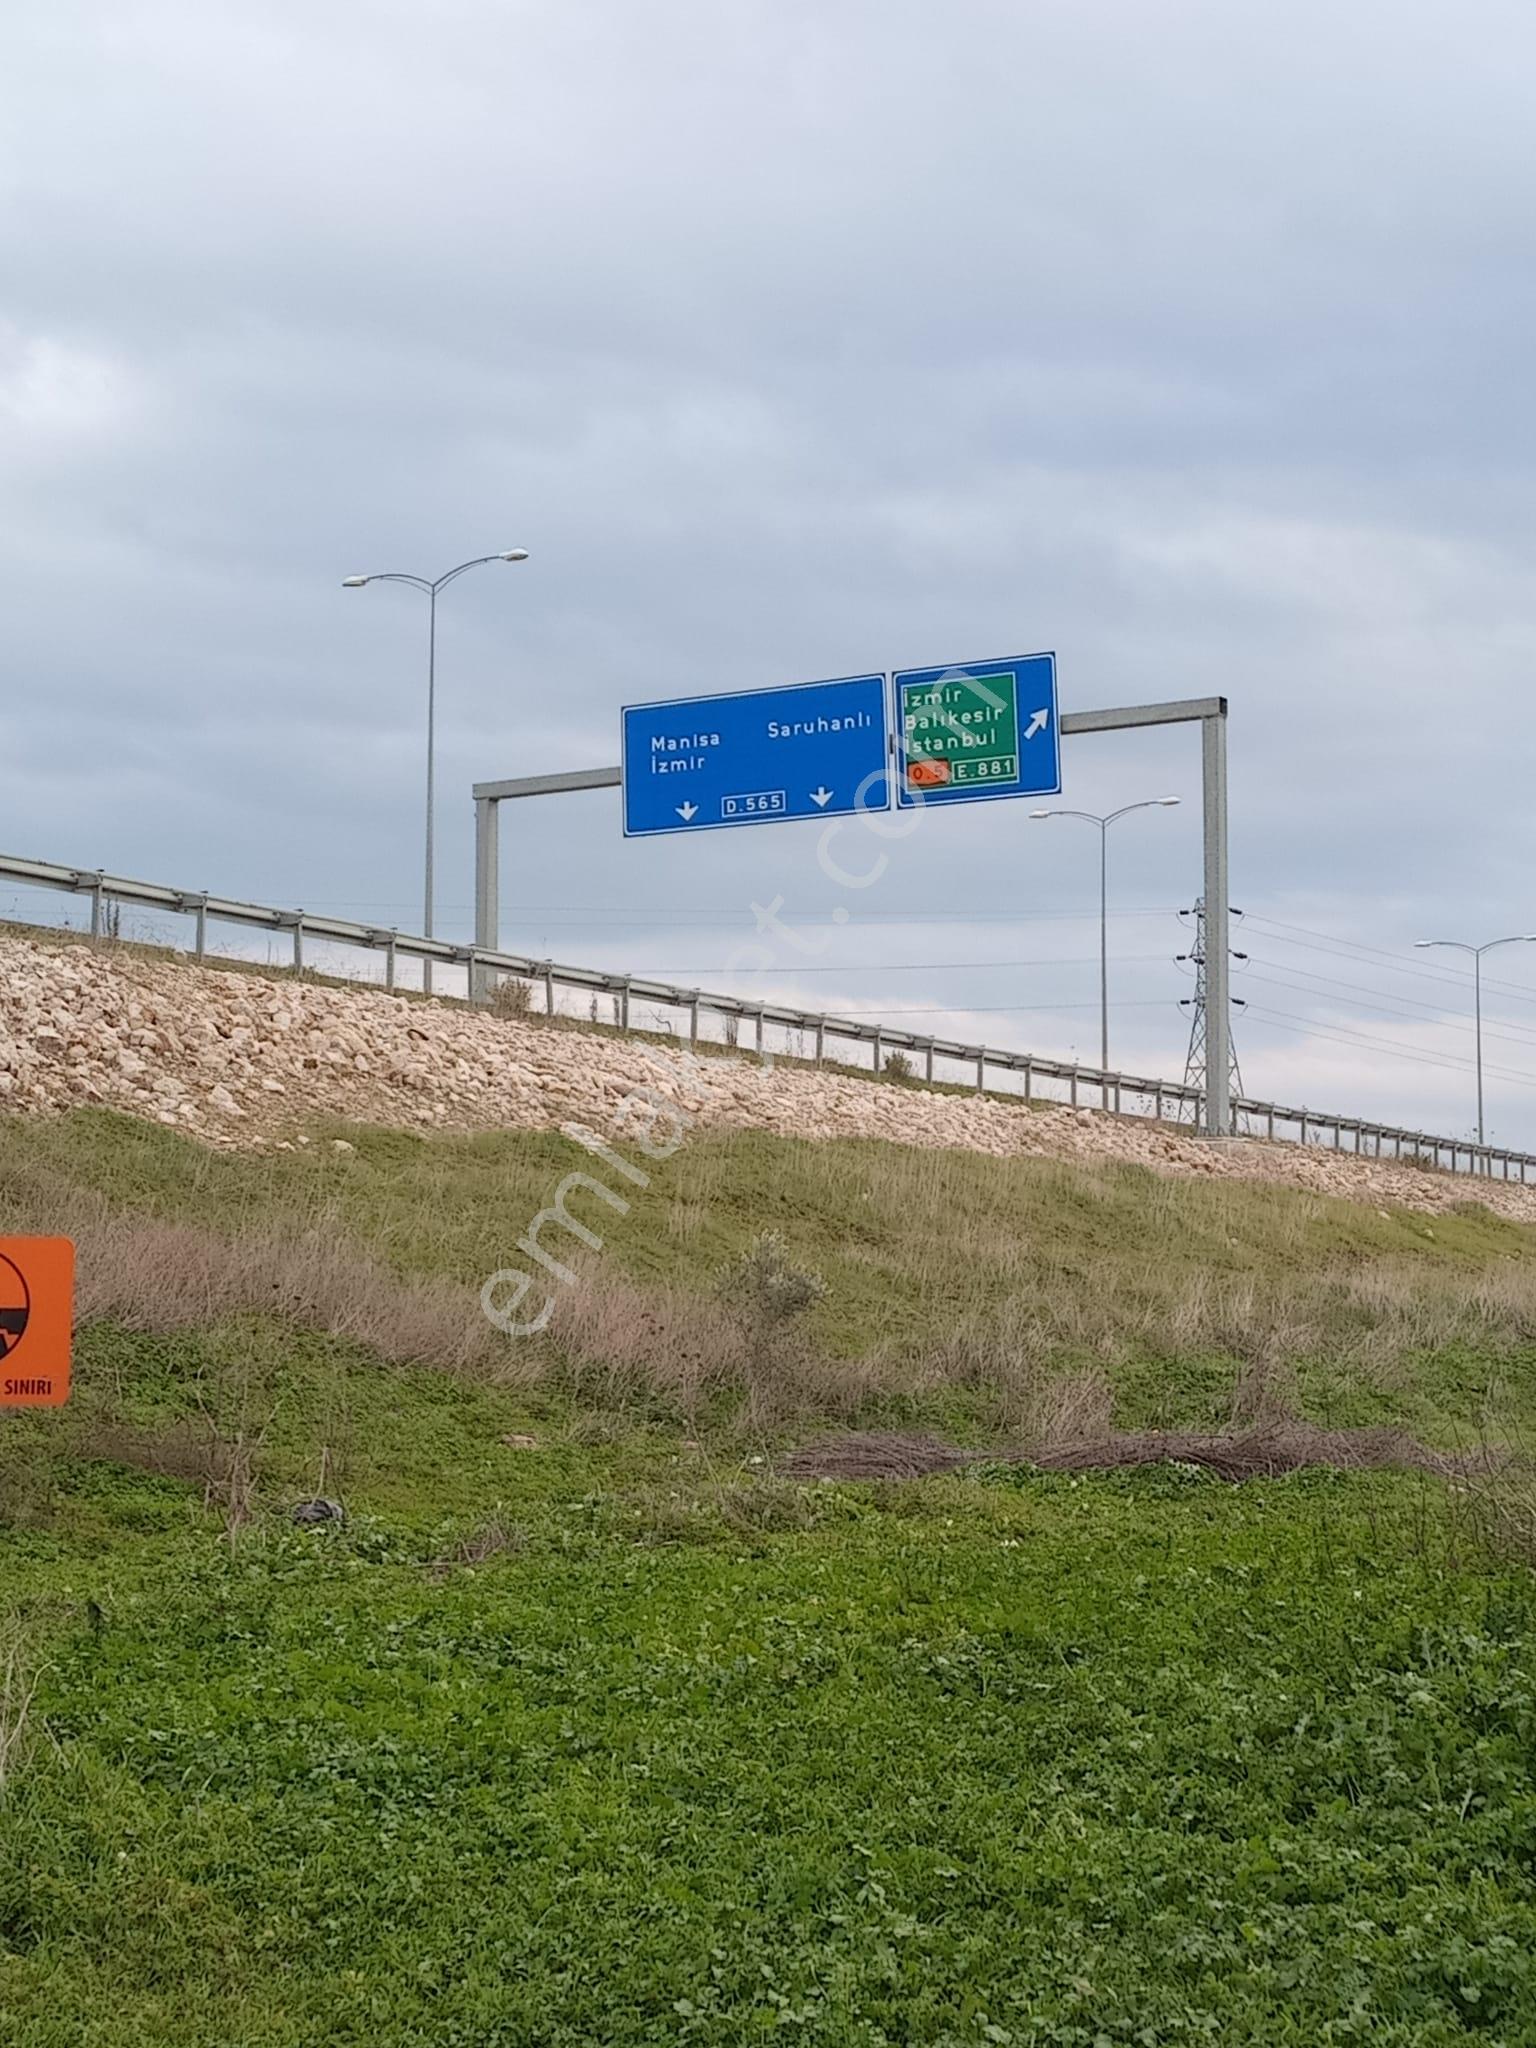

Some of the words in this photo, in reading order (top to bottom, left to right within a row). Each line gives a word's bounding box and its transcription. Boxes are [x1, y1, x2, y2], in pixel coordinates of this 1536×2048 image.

[768, 712, 872, 738] Saruhanlı
[905, 706, 1003, 731] Balıkesir
[651, 733, 719, 752] Manisa
[957, 760, 1011, 778] E.881
[726, 795, 782, 813] D.565
[4, 1379, 52, 1395] SINIRI
